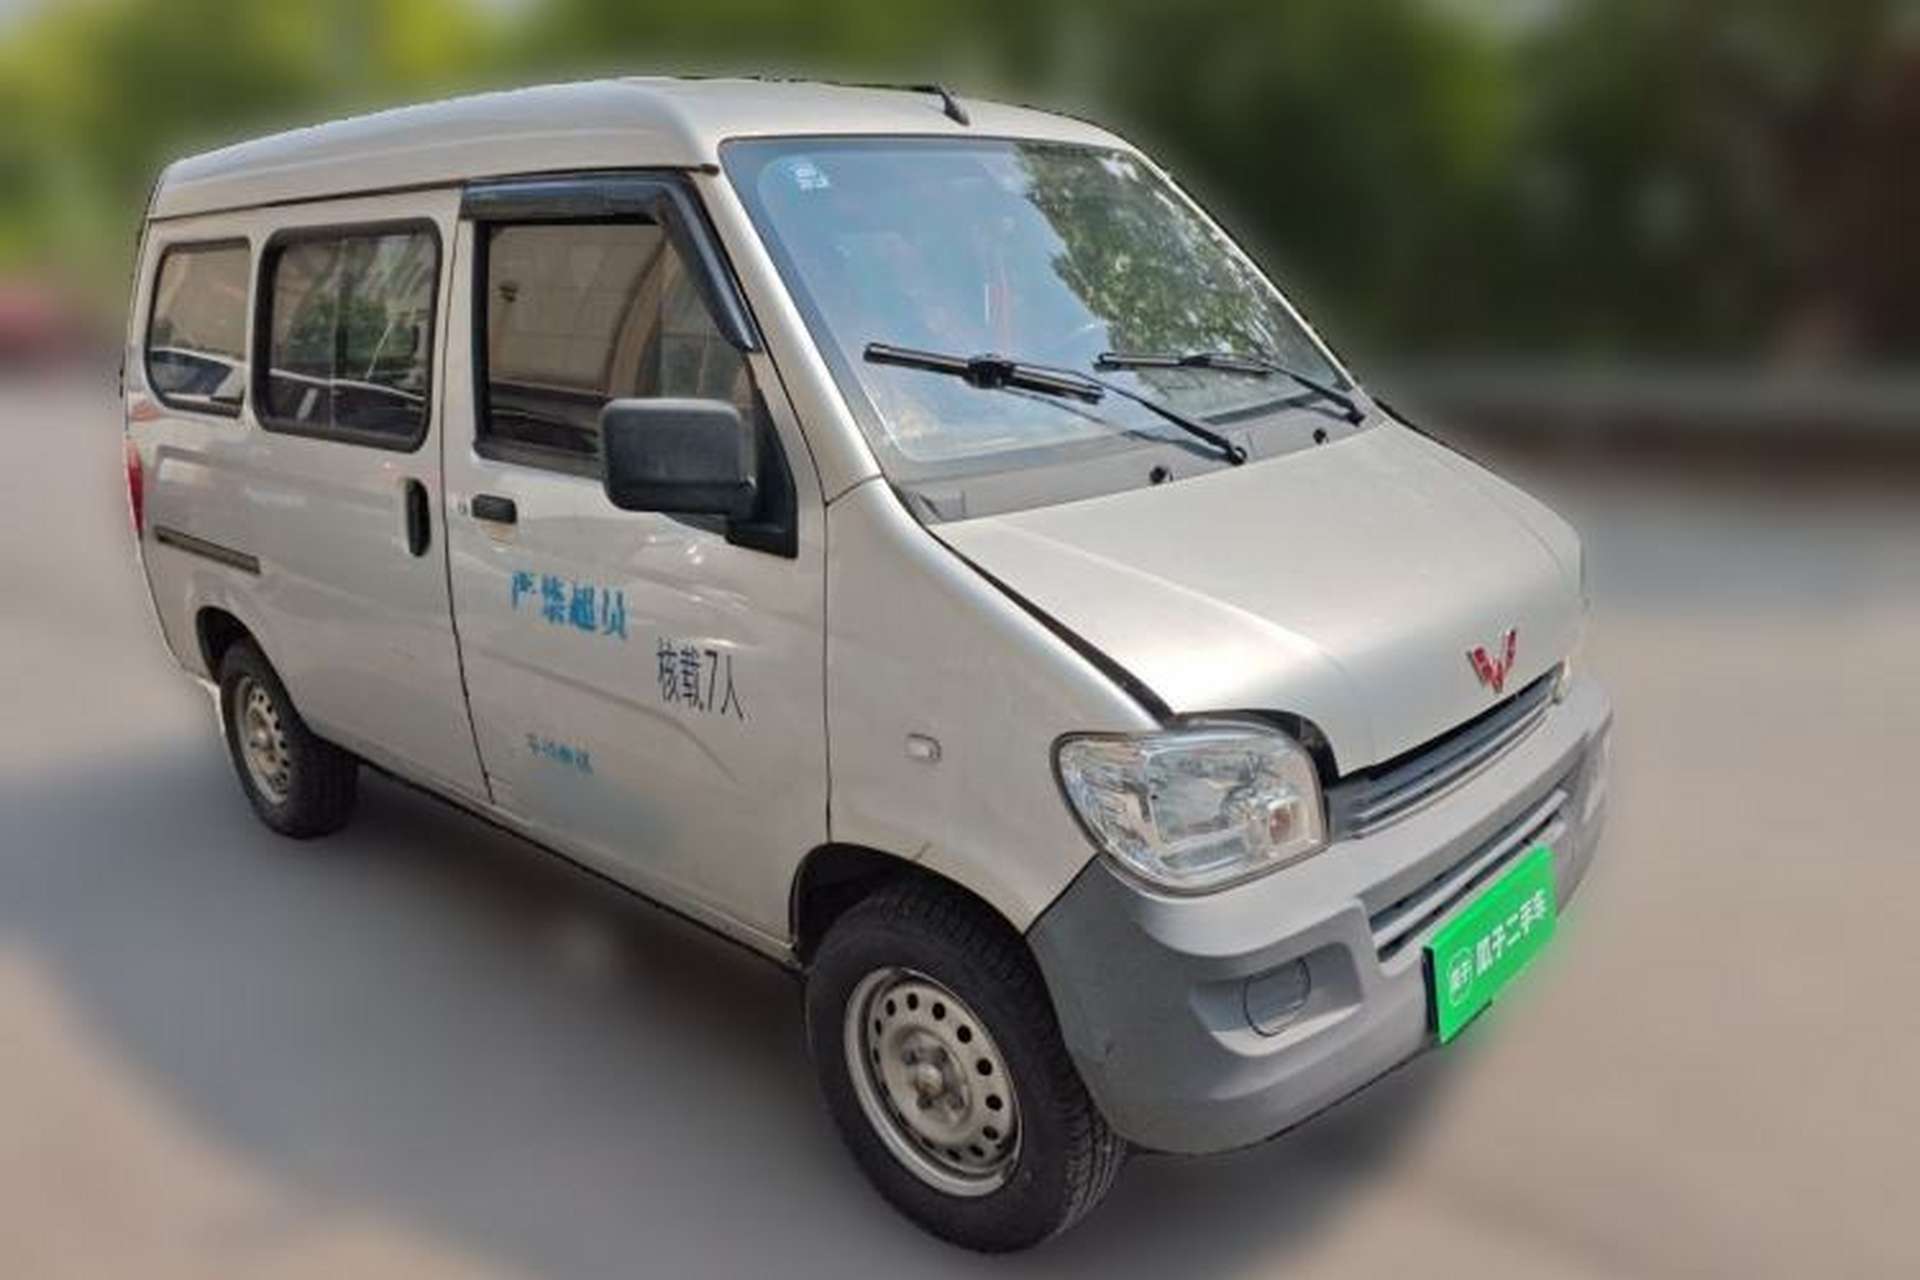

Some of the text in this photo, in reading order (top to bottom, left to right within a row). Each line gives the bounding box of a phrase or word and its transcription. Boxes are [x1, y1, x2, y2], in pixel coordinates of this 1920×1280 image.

[656, 637, 745, 720] 核载7人
[1475, 889, 1548, 977] 瓜子二手车
